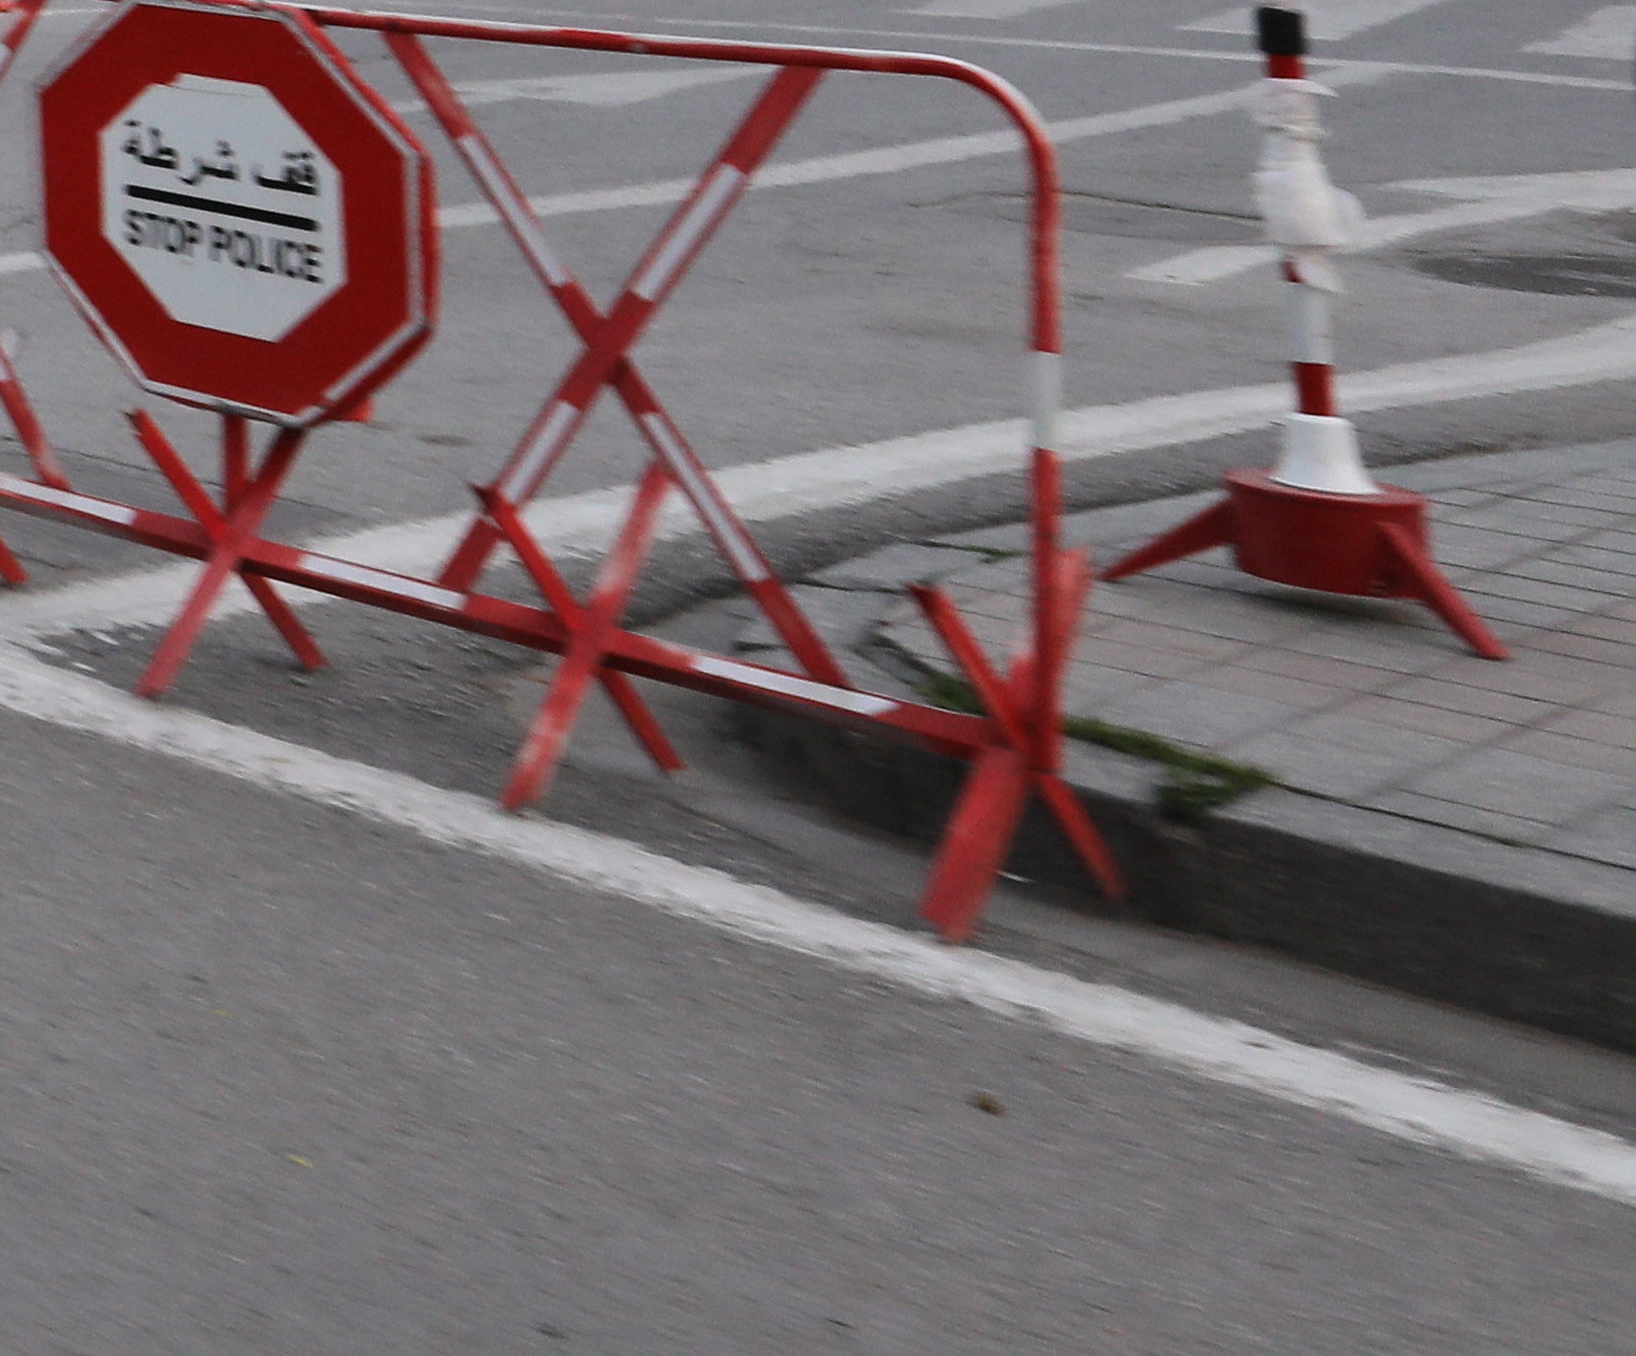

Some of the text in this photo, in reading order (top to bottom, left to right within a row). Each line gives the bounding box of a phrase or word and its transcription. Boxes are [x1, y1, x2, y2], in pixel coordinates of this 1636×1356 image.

[122, 119, 321, 196] قف شرطة
[123, 208, 325, 285] STOP POLICE
